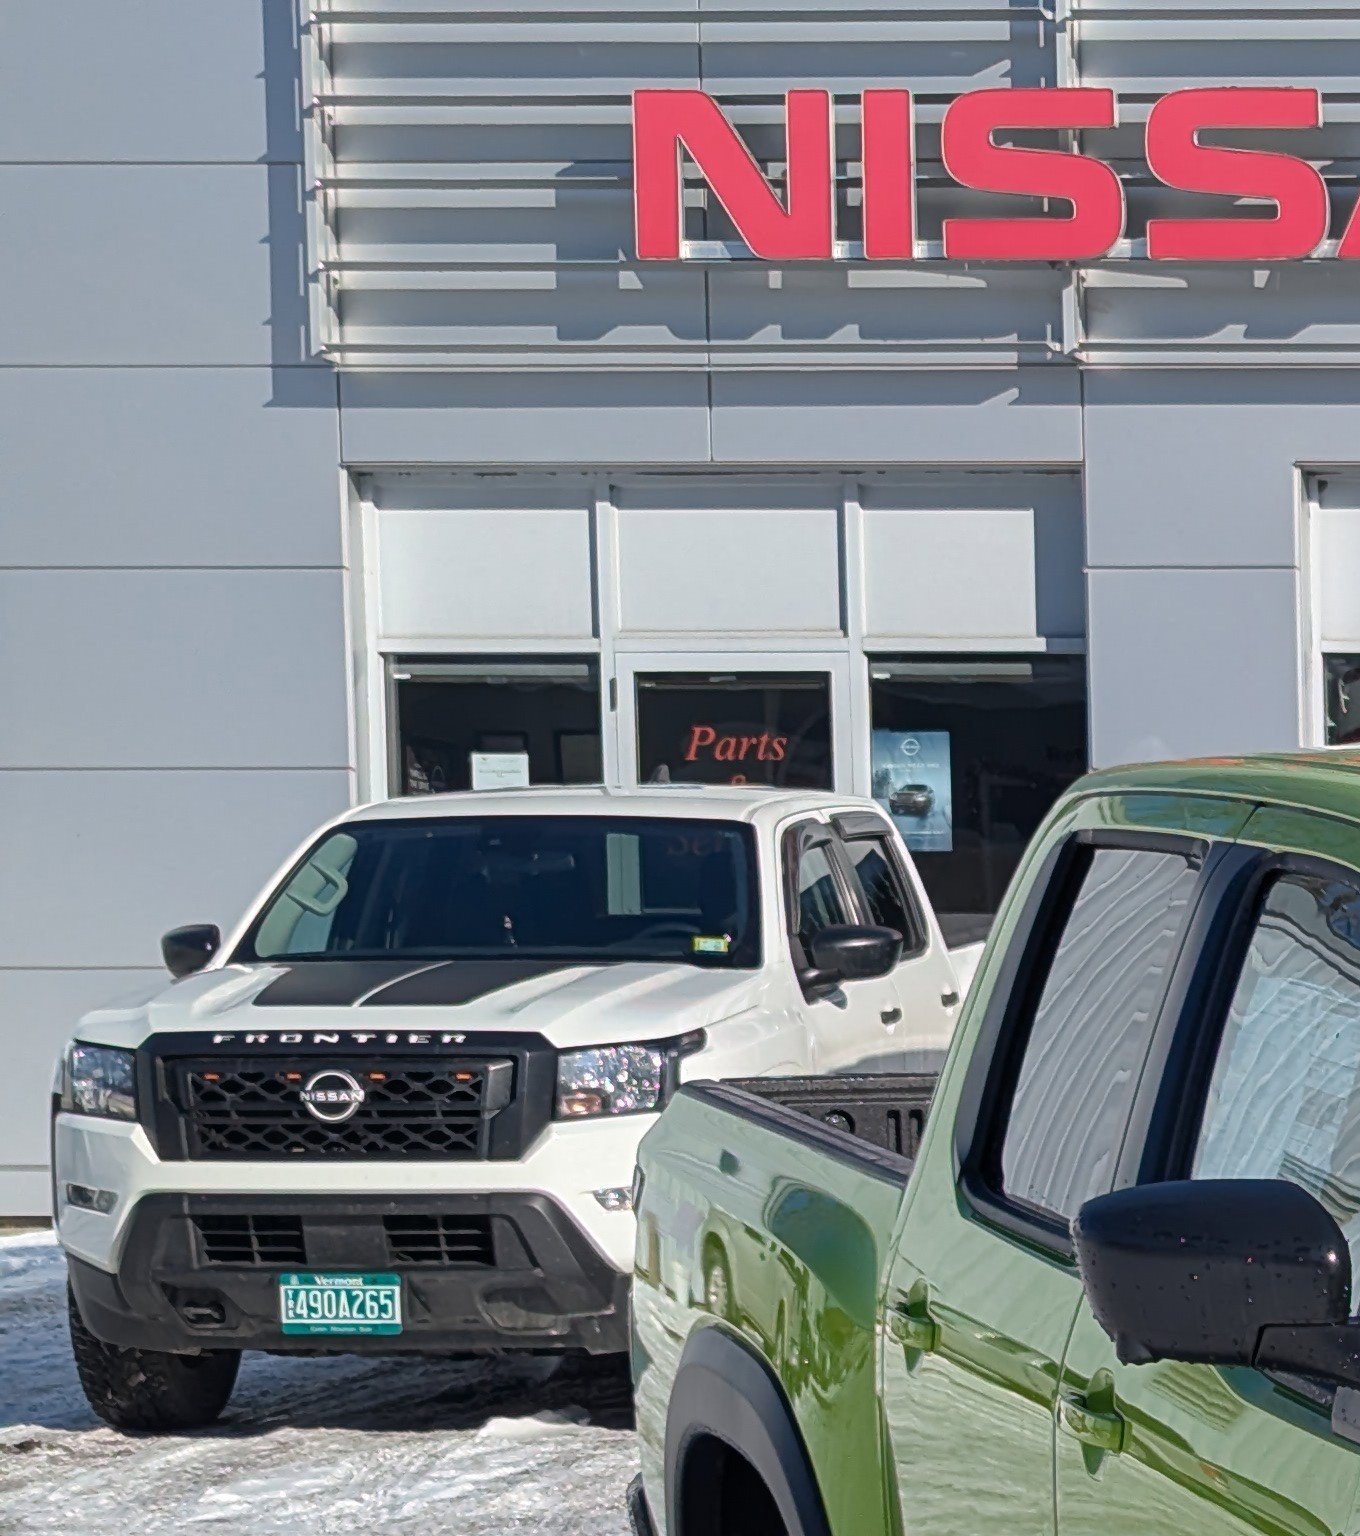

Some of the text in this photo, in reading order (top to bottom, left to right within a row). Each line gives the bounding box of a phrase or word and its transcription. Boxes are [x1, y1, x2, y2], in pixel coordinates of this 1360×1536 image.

[684, 724, 788, 761] Parts
[212, 1032, 467, 1044] FRONTIER
[299, 1089, 365, 1102] NISSAN
[295, 1289, 393, 1319] 490A265
